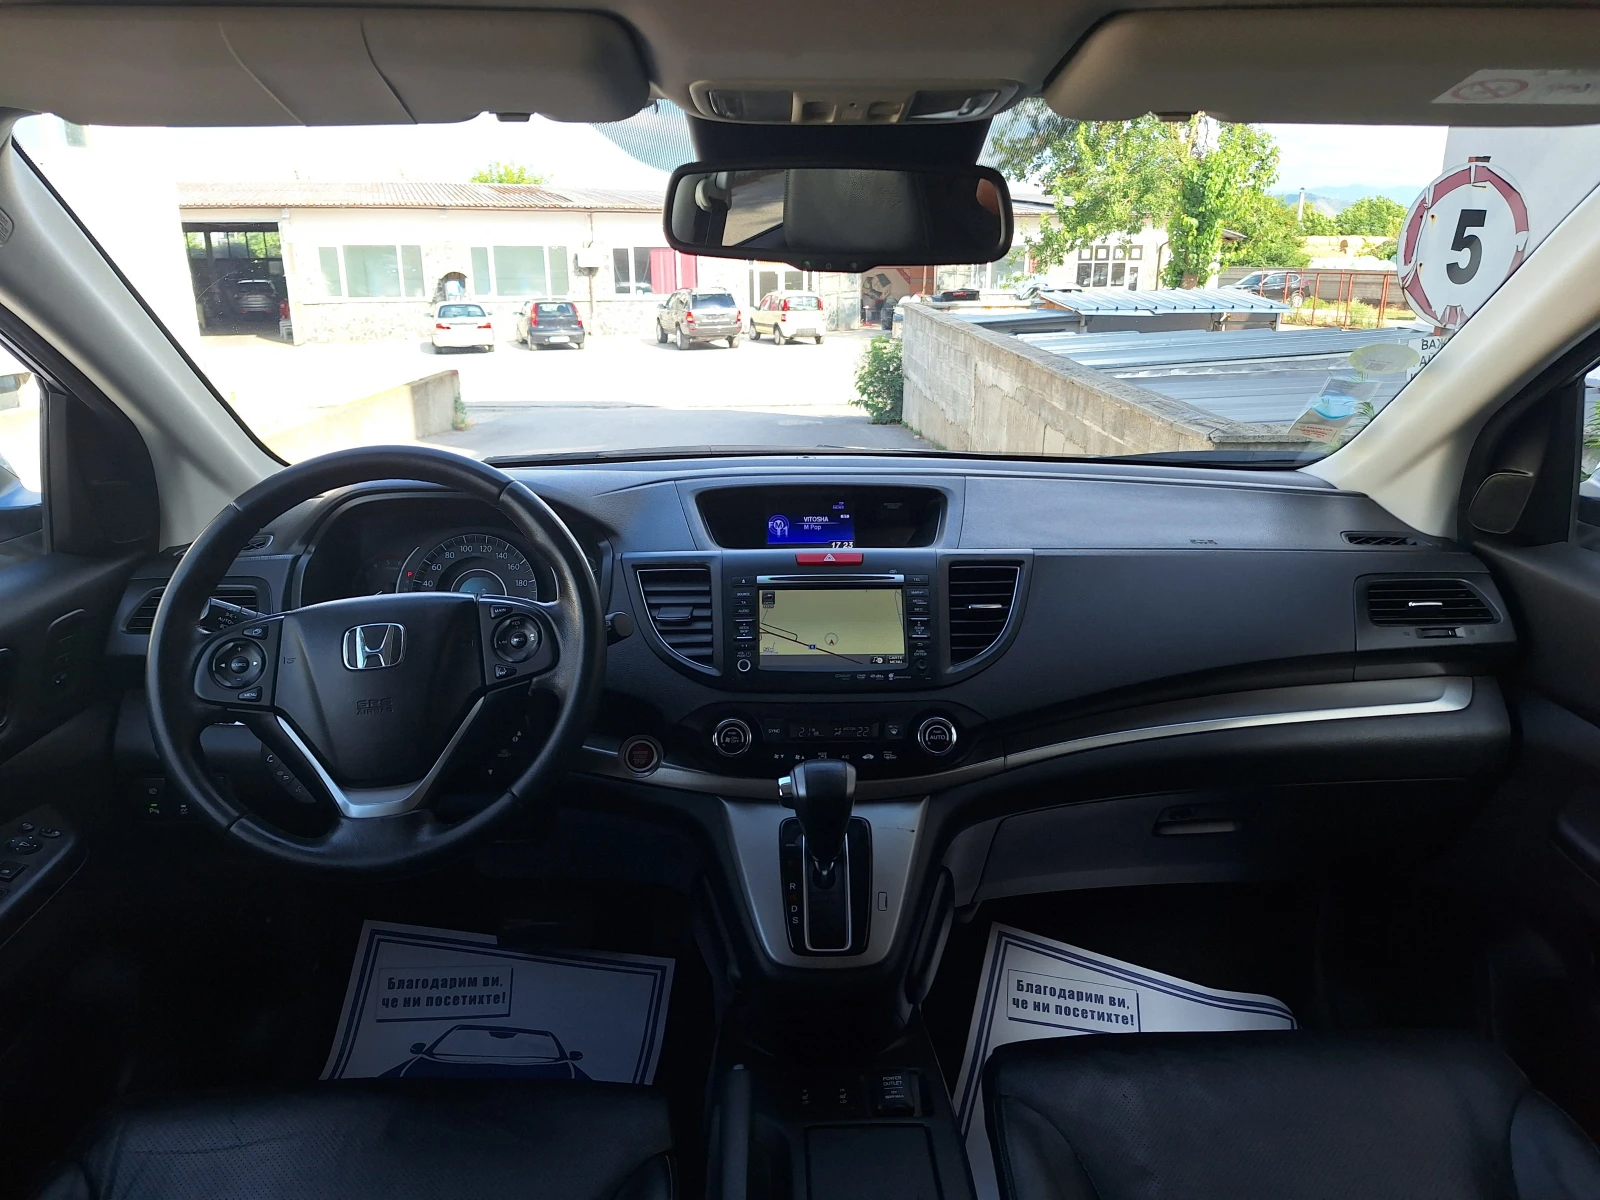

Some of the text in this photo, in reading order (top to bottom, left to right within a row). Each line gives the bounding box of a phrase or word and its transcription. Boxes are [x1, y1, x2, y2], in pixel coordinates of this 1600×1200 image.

[1446, 209, 1487, 285] 5
[460, 545, 473, 553] 100
[480, 545, 492, 553] 120
[496, 552, 508, 560] 140
[431, 563, 442, 571] 60
[507, 563, 520, 571] 160
[856, 726, 870, 737] 22
[791, 905, 798, 913] D
[792, 916, 799, 924] S
[387, 976, 478, 990] Благодарим
[1016, 979, 1130, 1010] Благодарим ви,
[381, 991, 506, 1009] че ни посетихте!
[1012, 997, 1135, 1026] че ни посетихте!
